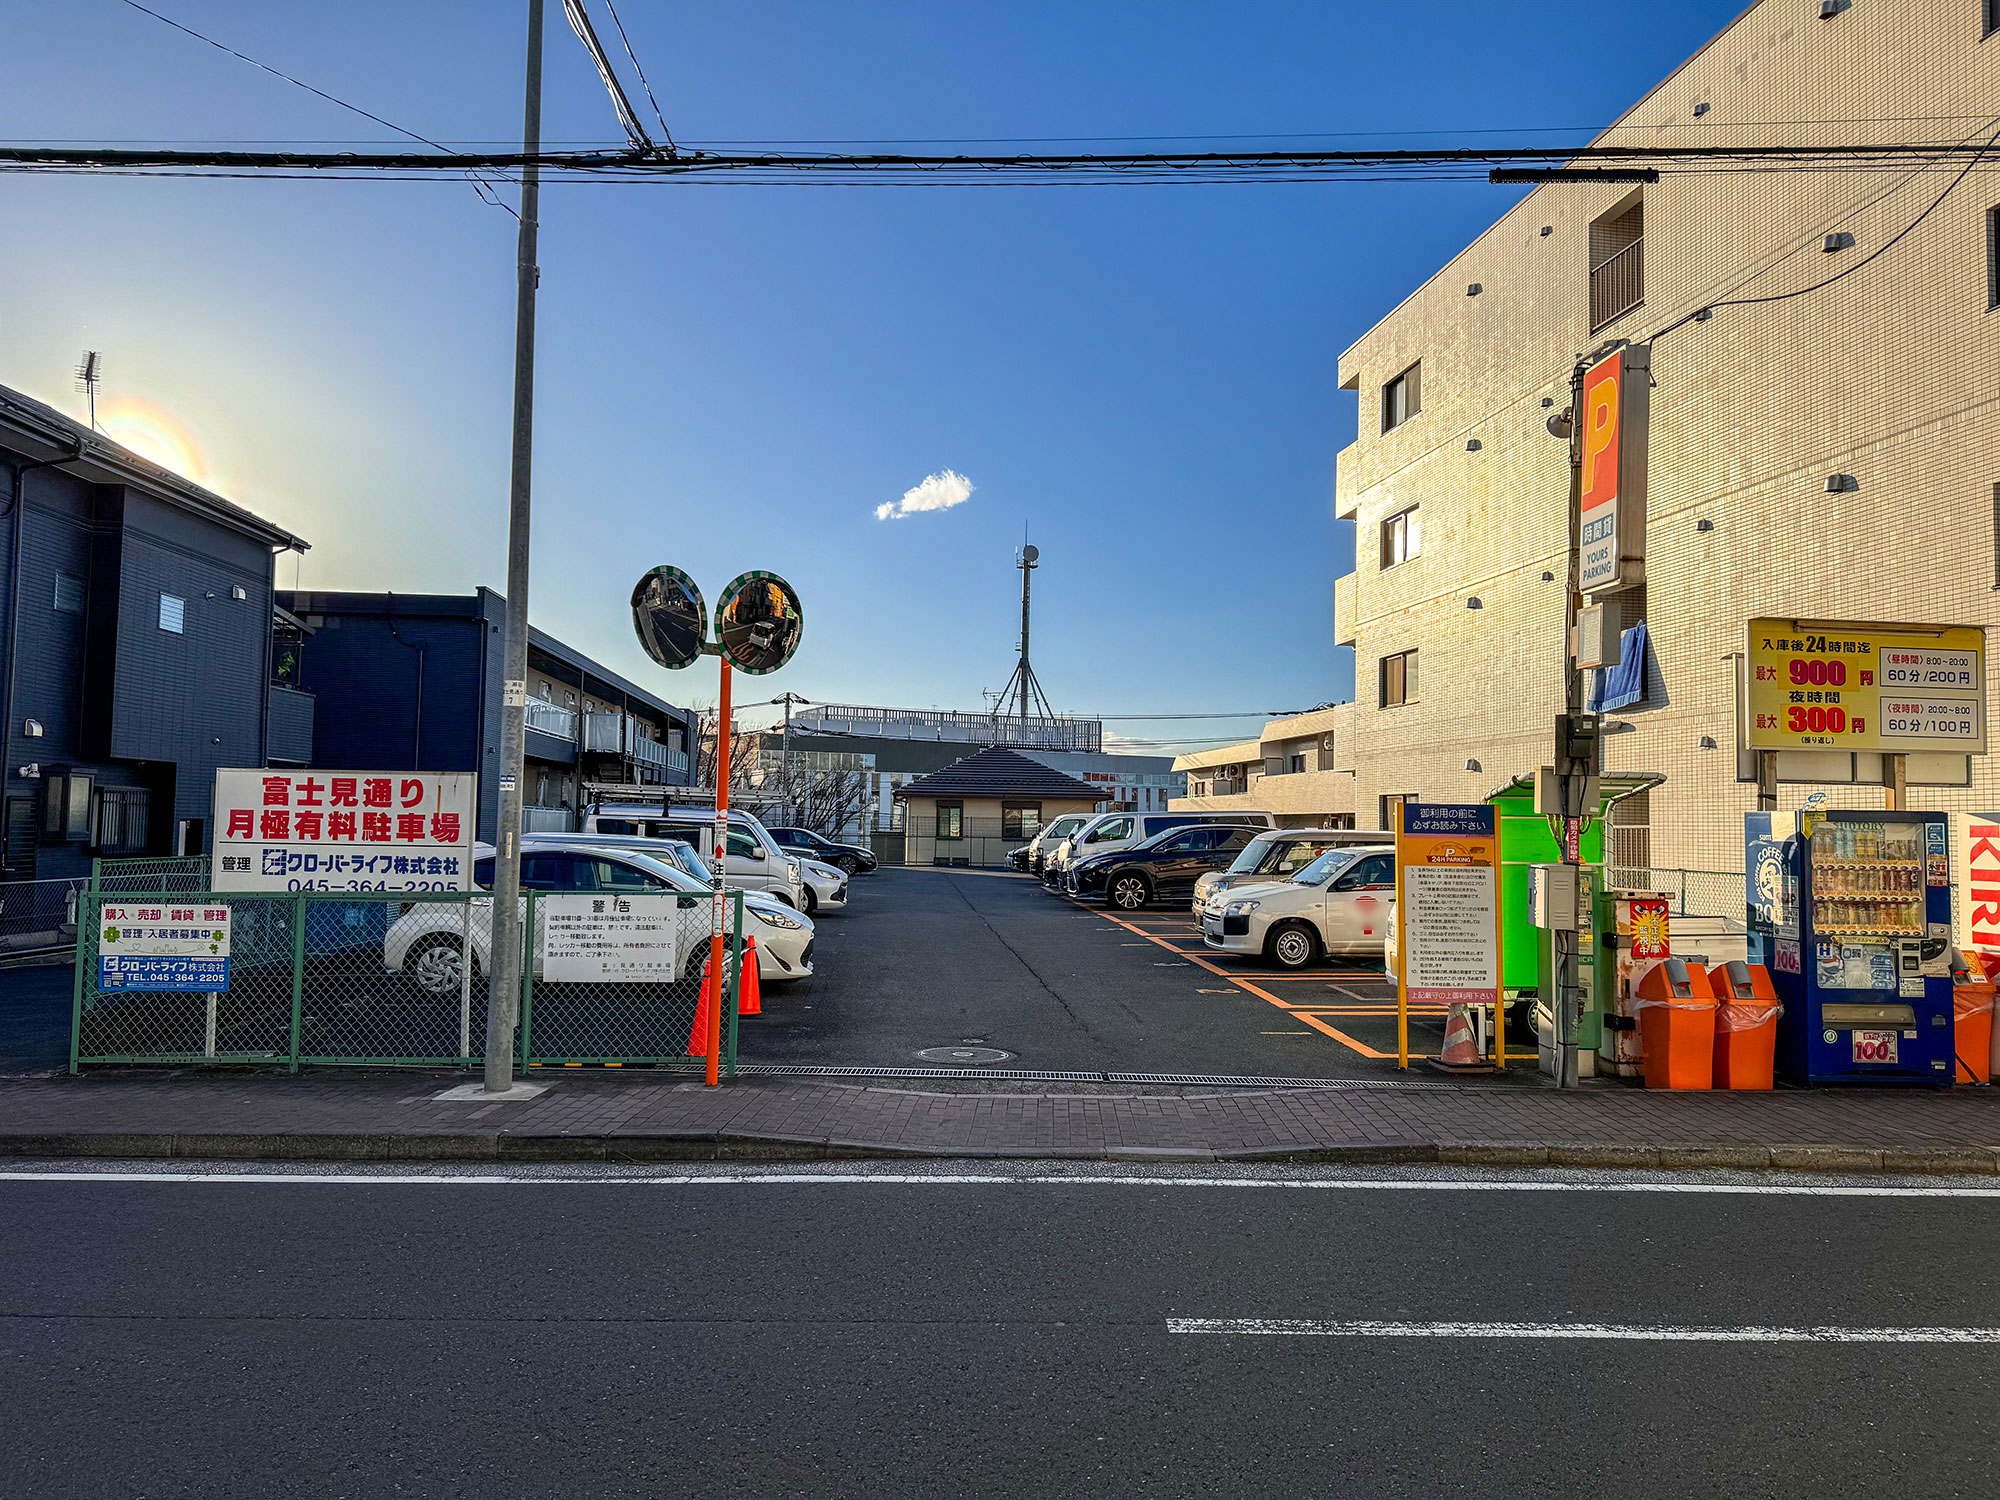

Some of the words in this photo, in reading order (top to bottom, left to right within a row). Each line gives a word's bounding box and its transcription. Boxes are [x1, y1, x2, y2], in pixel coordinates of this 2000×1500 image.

[1582, 376, 1618, 496] P
[1584, 515, 1613, 544] 時間貸
[1586, 547, 1609, 566] YOURS
[1582, 561, 1612, 581] PARKING
[1762, 636, 1871, 654] 入庫後24時間迄
[1755, 666, 1777, 681] 最大
[1789, 659, 1847, 686] 900
[1859, 670, 1874, 686] 円
[1788, 690, 1841, 704] 夜時間
[1756, 714, 1778, 729] 最大
[1787, 706, 1846, 733] 300
[1851, 717, 1865, 733] 円
[261, 776, 424, 809] 富士見通り
[1420, 808, 1477, 819] 御利用の前に
[226, 809, 461, 843] 月極有料駐車場
[1412, 820, 1486, 830] 必ずお読み下さい
[221, 856, 252, 871] 管理
[287, 853, 459, 875] クローバーライフ株式会社
[1757, 846, 1785, 864] COFFEE
[714, 862, 724, 891] 注意
[592, 900, 631, 913] 警告
[1639, 925, 1650, 955] 監視中
[120, 961, 225, 972] クローバーライフ株式会社
[1775, 949, 1796, 970] 100
[1855, 1041, 1889, 1060] 100
